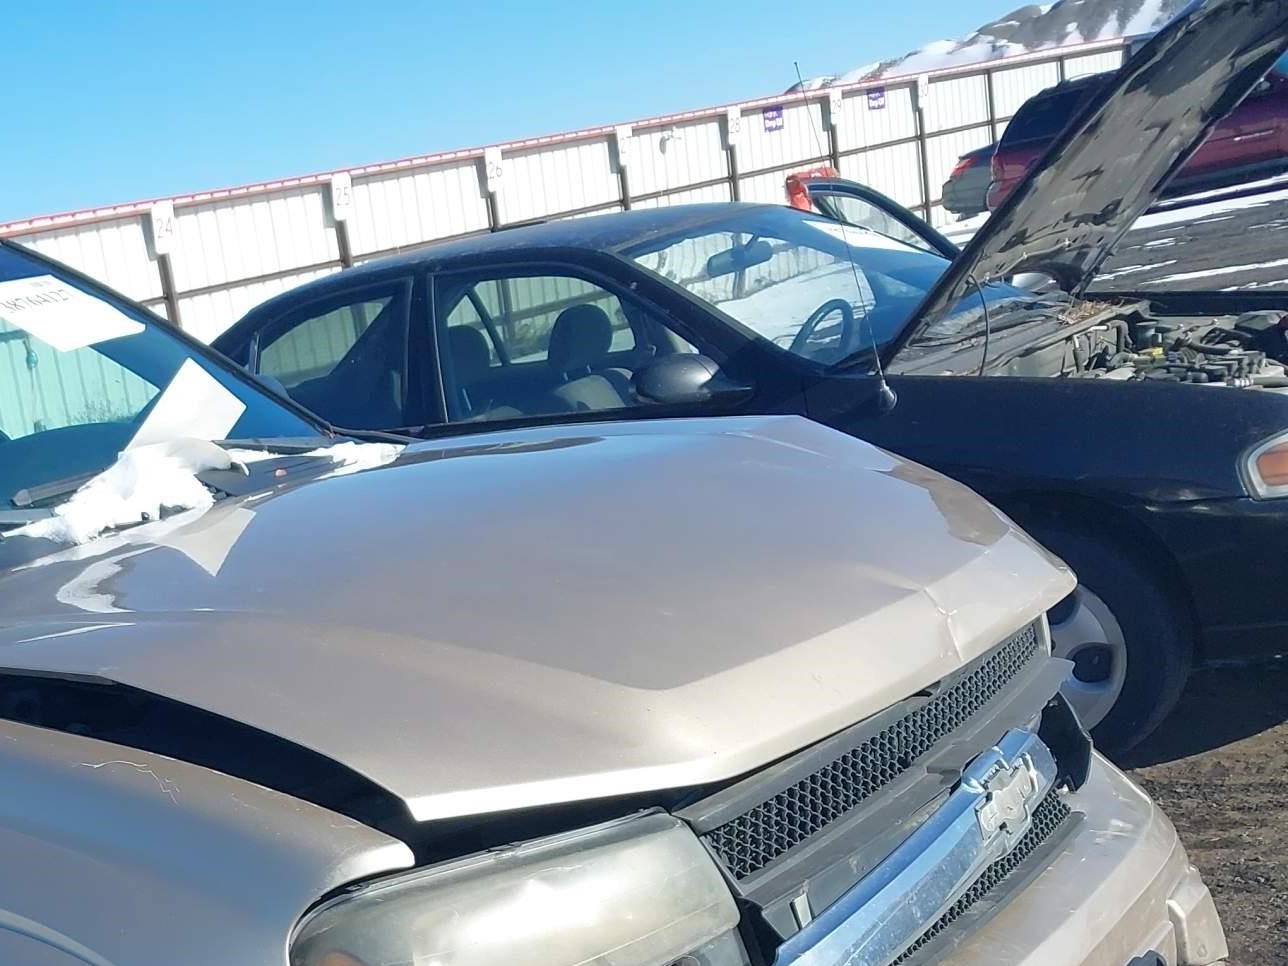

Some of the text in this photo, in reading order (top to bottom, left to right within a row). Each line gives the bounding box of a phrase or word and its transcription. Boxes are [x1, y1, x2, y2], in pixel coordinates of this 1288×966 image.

[729, 117, 742, 134] 28
[488, 161, 502, 180] 26
[335, 186, 350, 206] 25
[155, 215, 173, 239] 24
